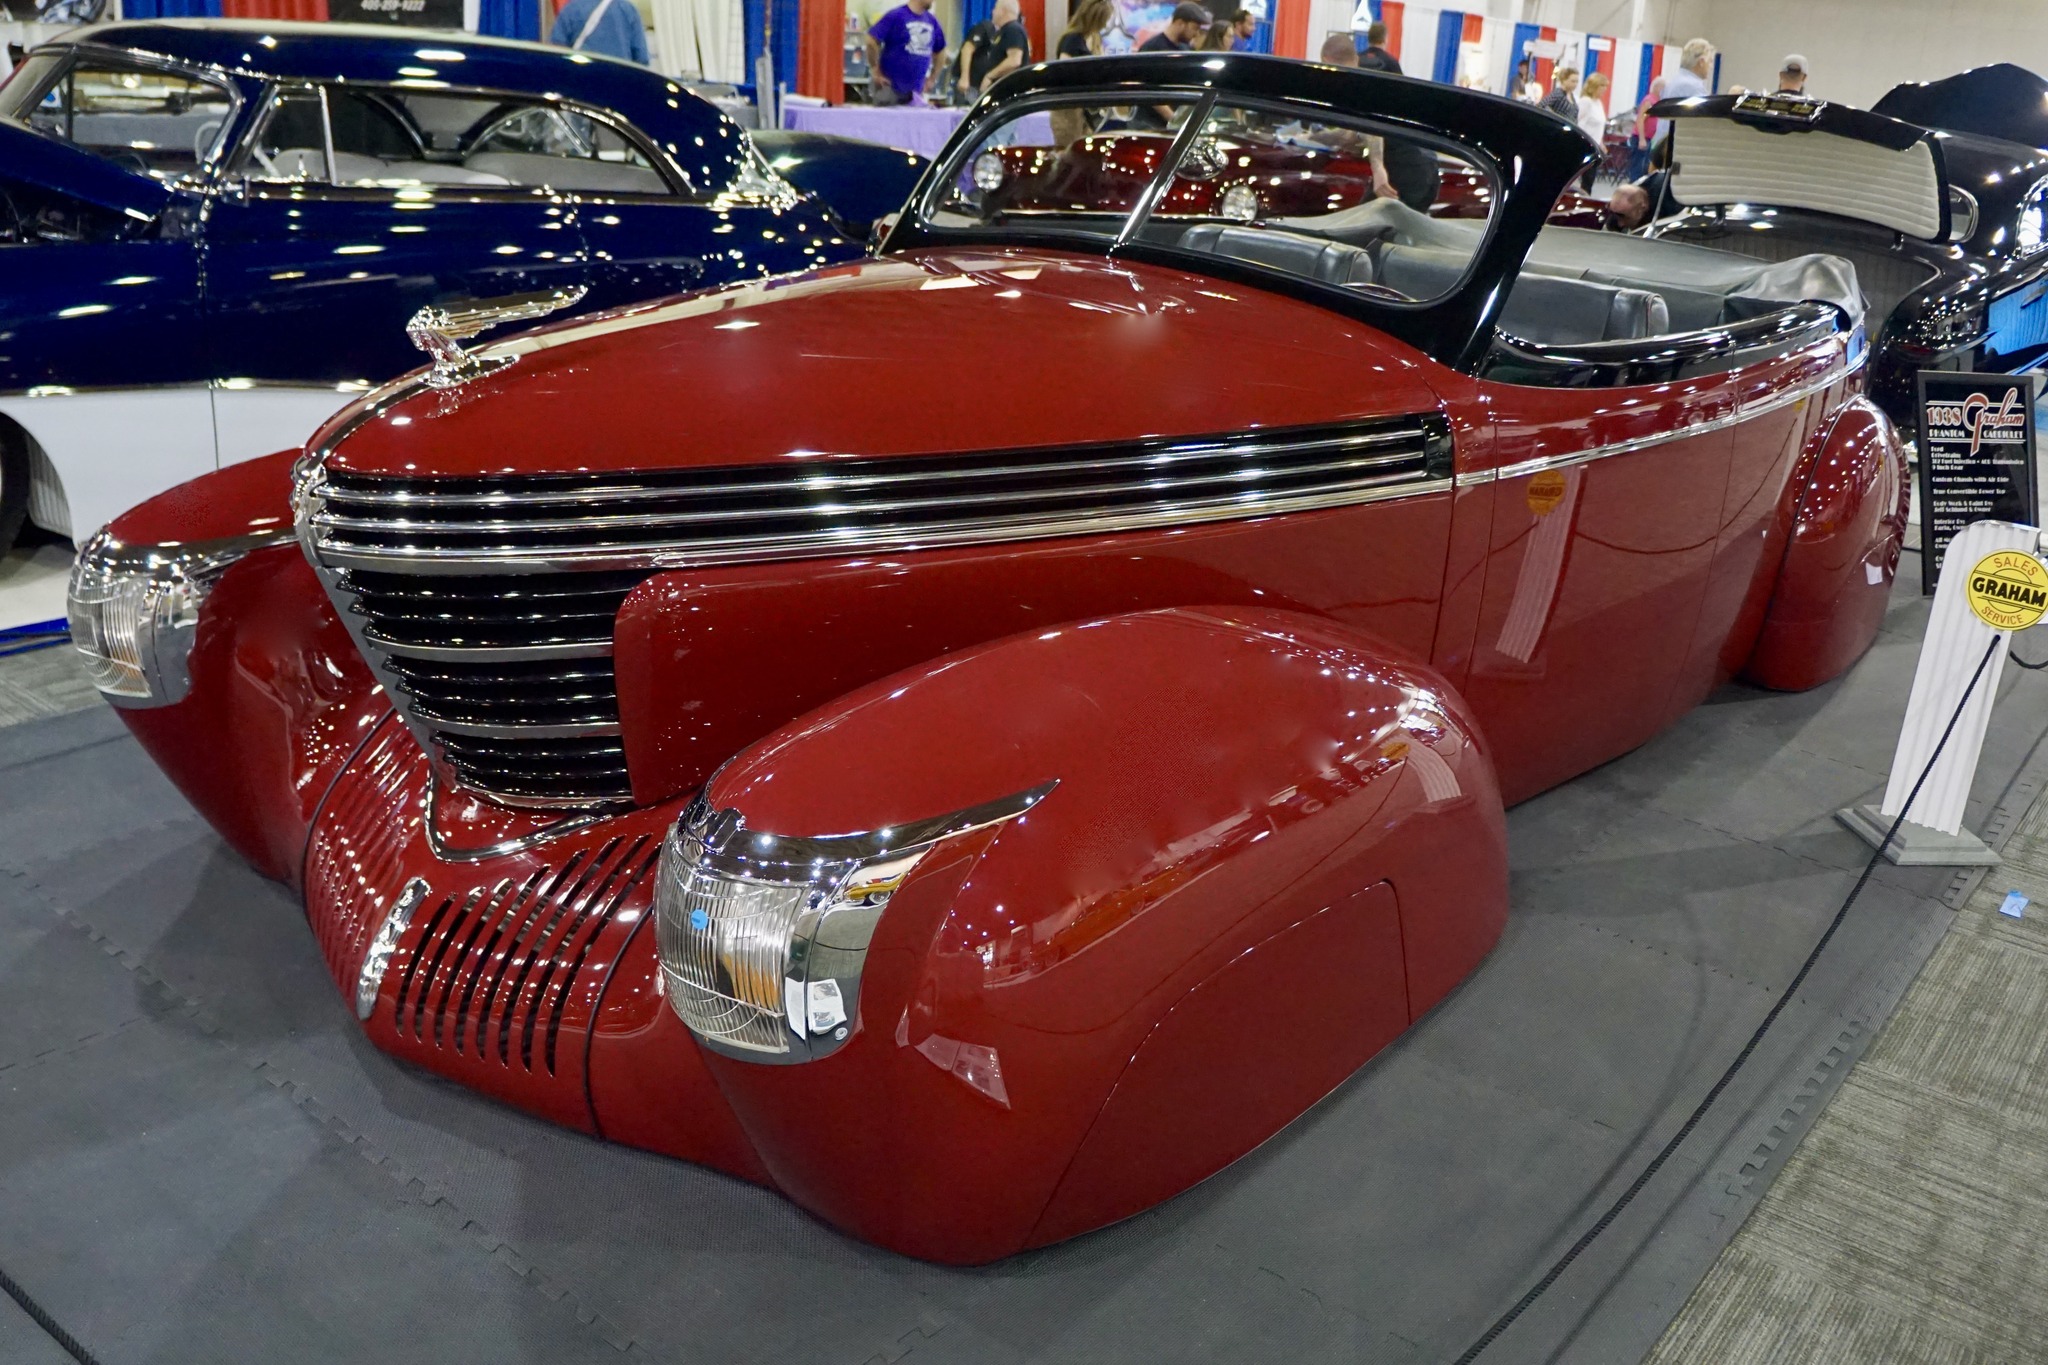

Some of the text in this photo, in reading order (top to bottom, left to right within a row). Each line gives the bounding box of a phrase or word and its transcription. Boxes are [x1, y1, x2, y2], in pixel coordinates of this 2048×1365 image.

[1926, 387, 2025, 457] 1938 Graham
[1928, 429, 2024, 439] PHANTOM CABRIOLET
[1994, 556, 2038, 576] SALES
[1972, 577, 2047, 607] GRAHAM
[1981, 606, 2024, 625] SERVICE
